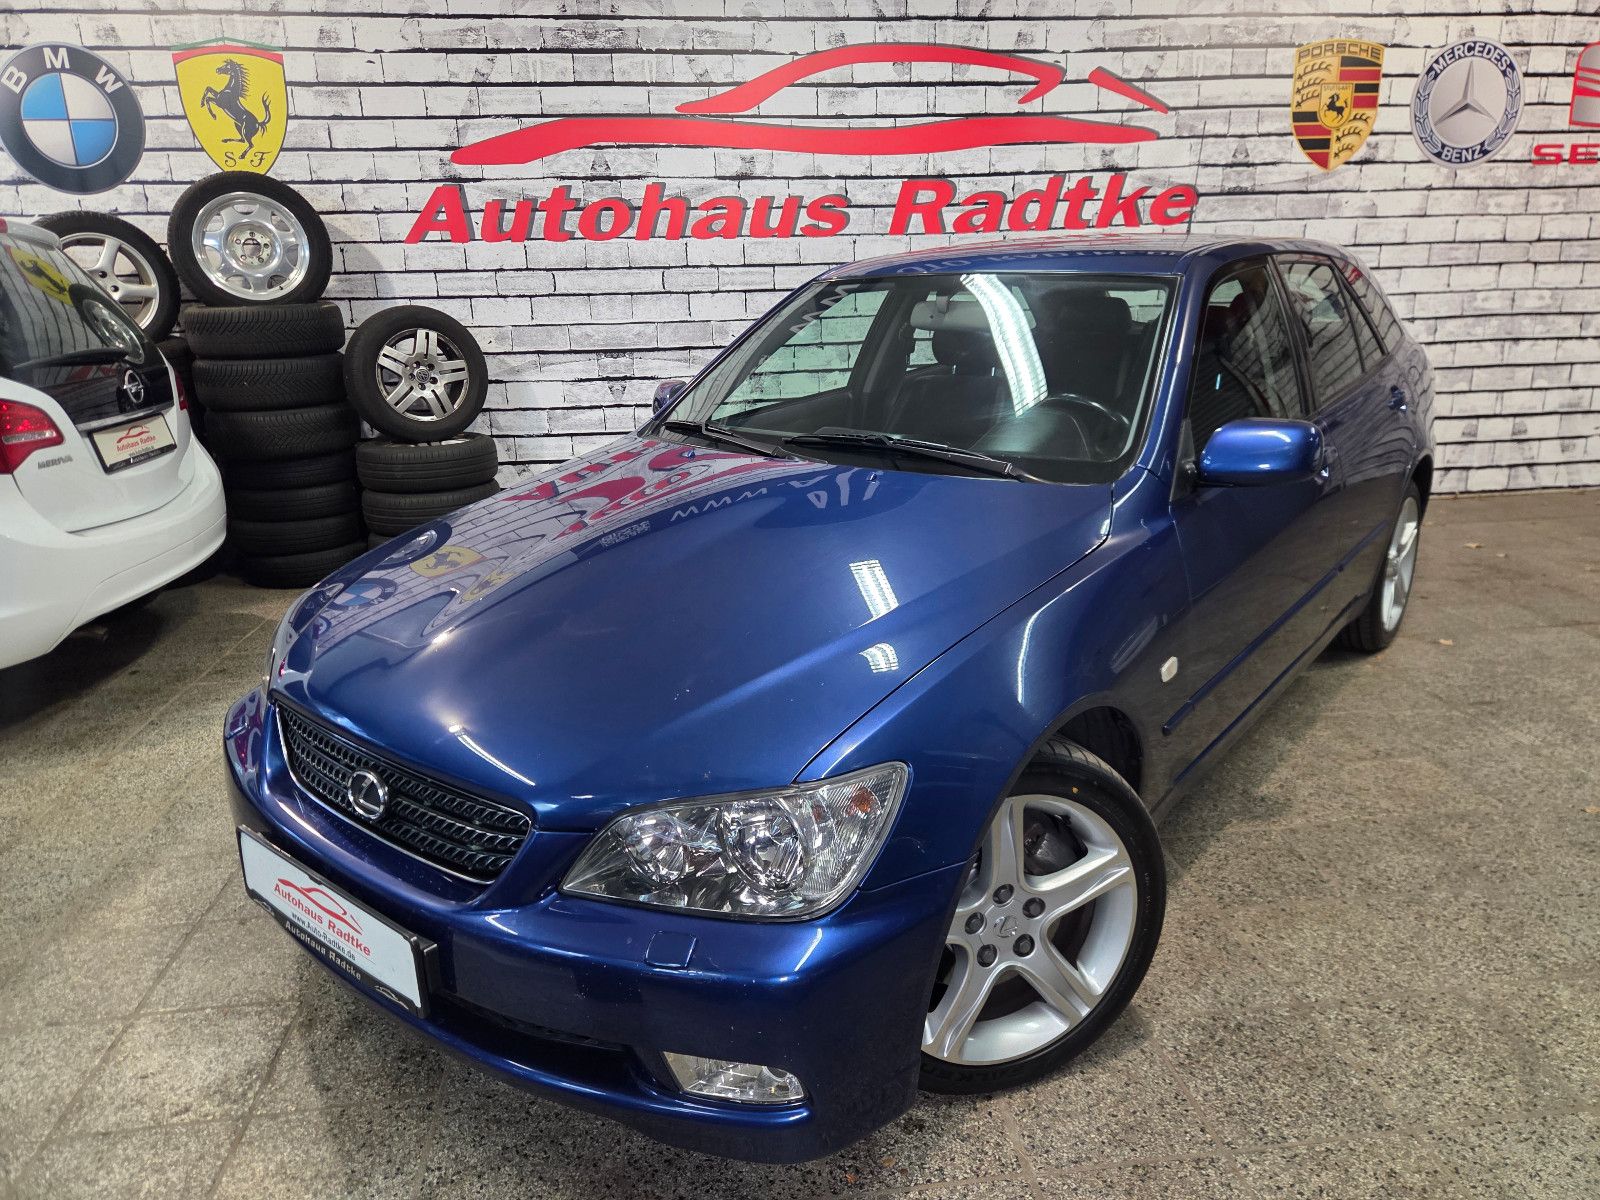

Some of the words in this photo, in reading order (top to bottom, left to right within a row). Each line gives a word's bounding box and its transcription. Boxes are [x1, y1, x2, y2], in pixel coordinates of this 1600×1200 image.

[1297, 42, 1382, 63] PORSCHE
[1433, 41, 1512, 75] MERCEDES
[2, 47, 124, 94] BMW
[224, 151, 237, 168] S
[249, 151, 273, 168] F
[1441, 143, 1484, 163] BENZ
[403, 182, 852, 244] Autohaus
[888, 172, 1199, 236] Radtke
[273, 882, 324, 925] Autohaus
[326, 918, 371, 957] Radtke
[328, 950, 361, 981] Radtke
